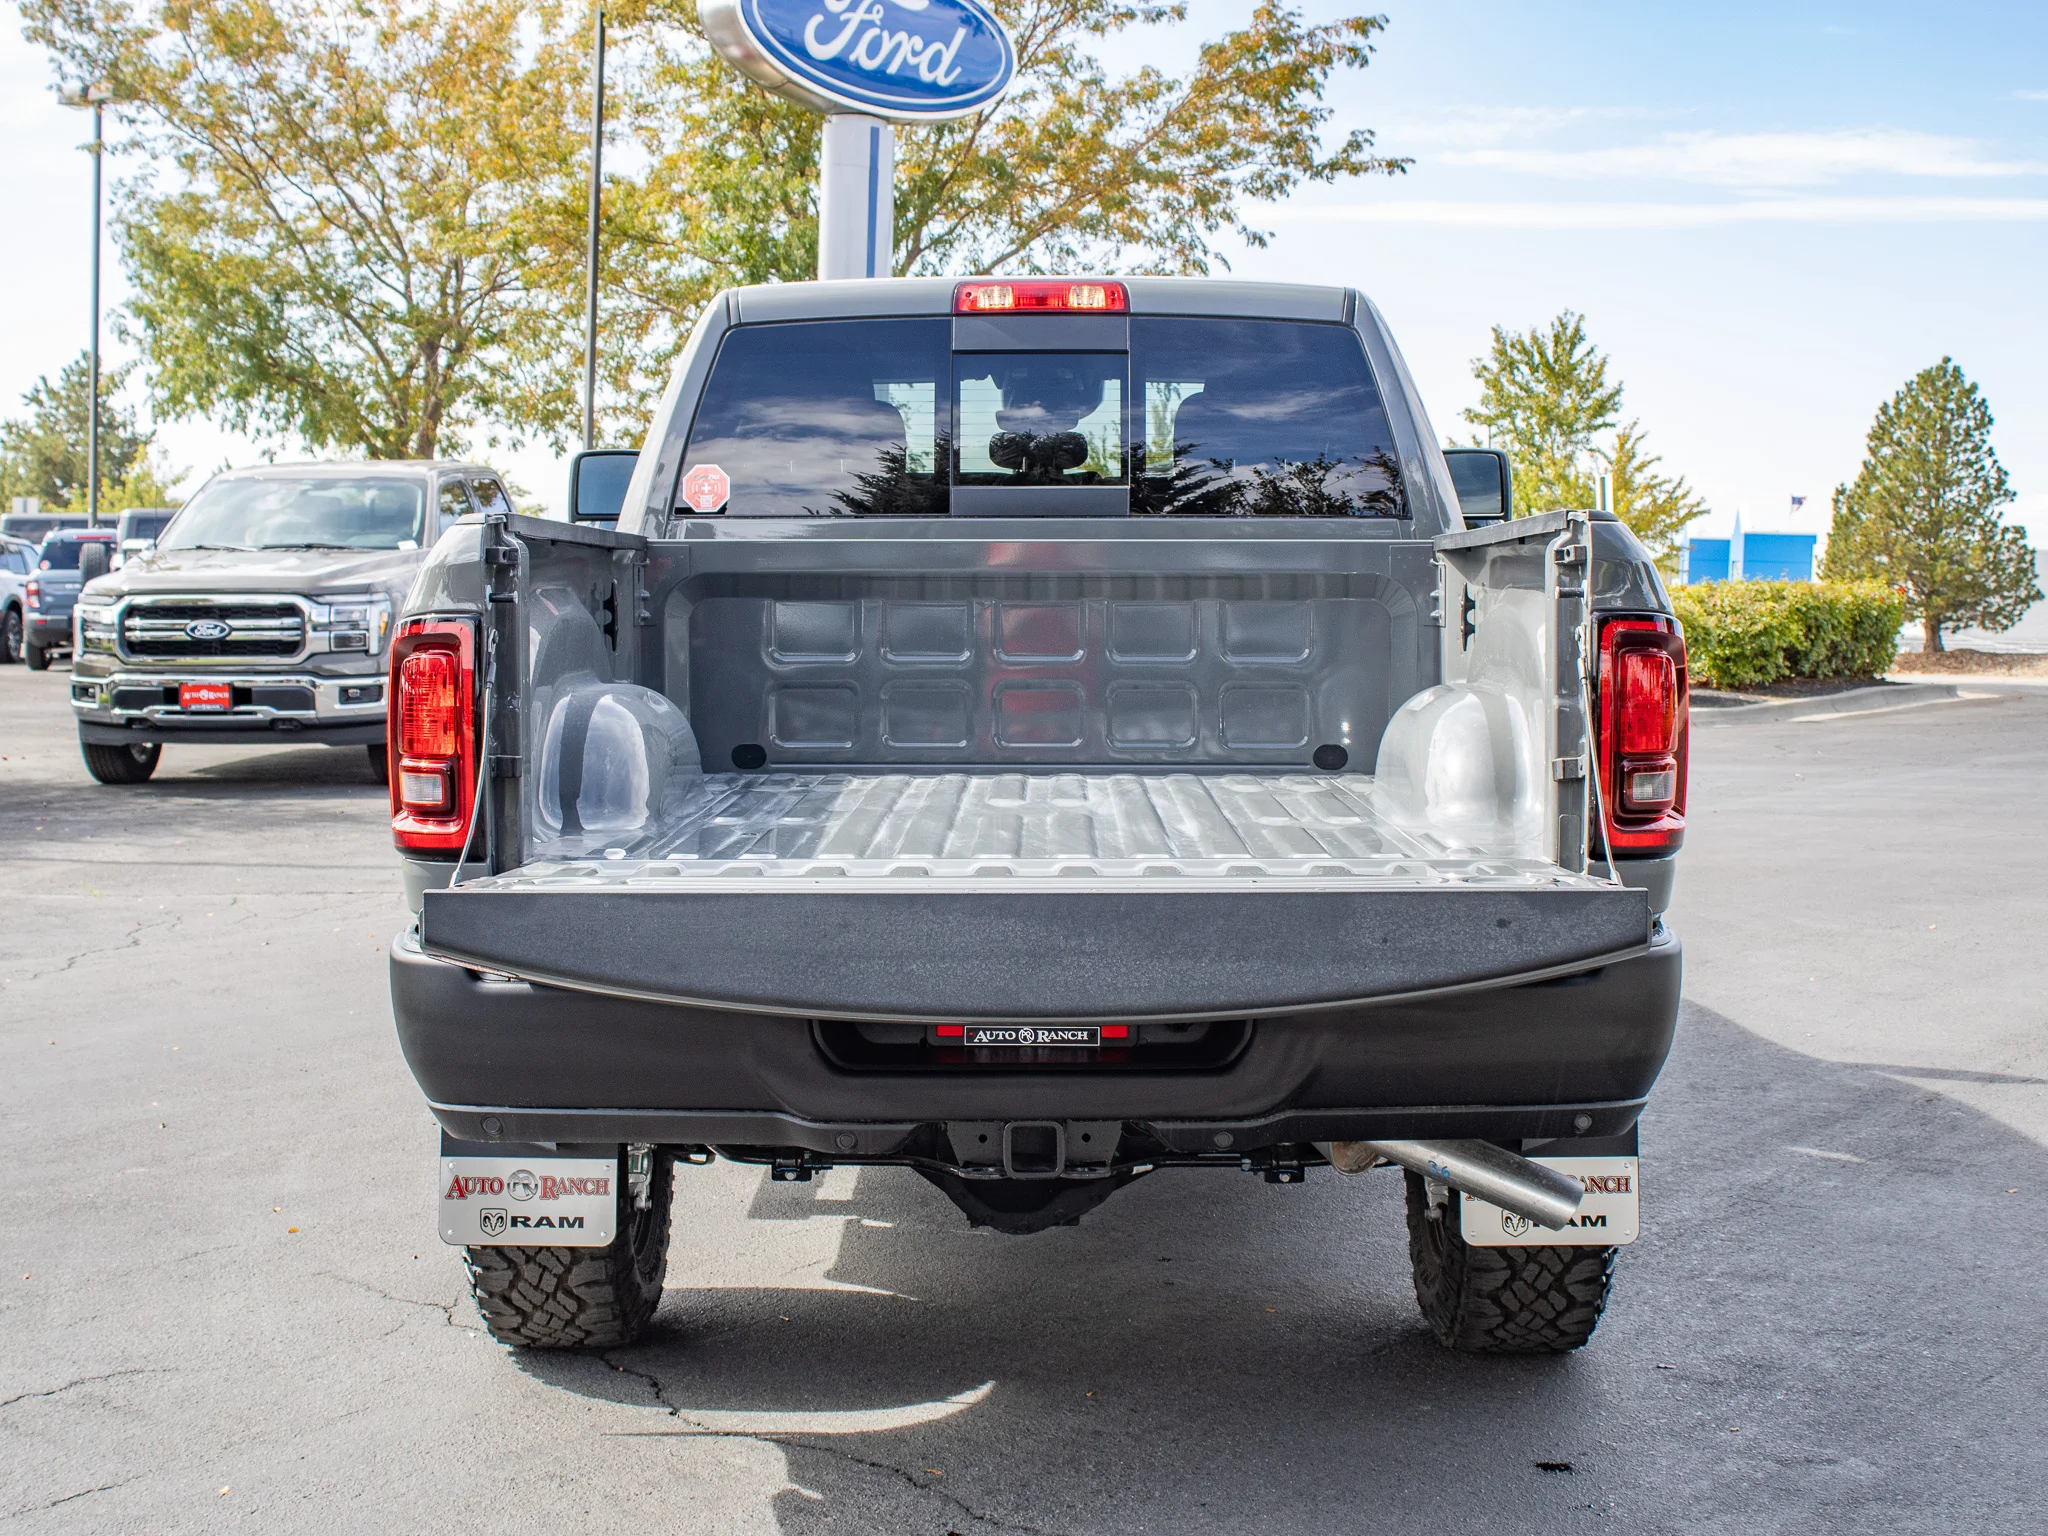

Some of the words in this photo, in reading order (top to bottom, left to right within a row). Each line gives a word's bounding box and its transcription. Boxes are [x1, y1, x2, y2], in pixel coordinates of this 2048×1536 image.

[804, 0, 967, 86] Ford
[195, 624, 221, 636] Ford
[973, 1030, 1016, 1042] AUTO
[1036, 1030, 1088, 1042] RANCH
[445, 1175, 504, 1200] AUTO
[539, 1176, 610, 1200] RANCH
[510, 1216, 584, 1228] RAM
